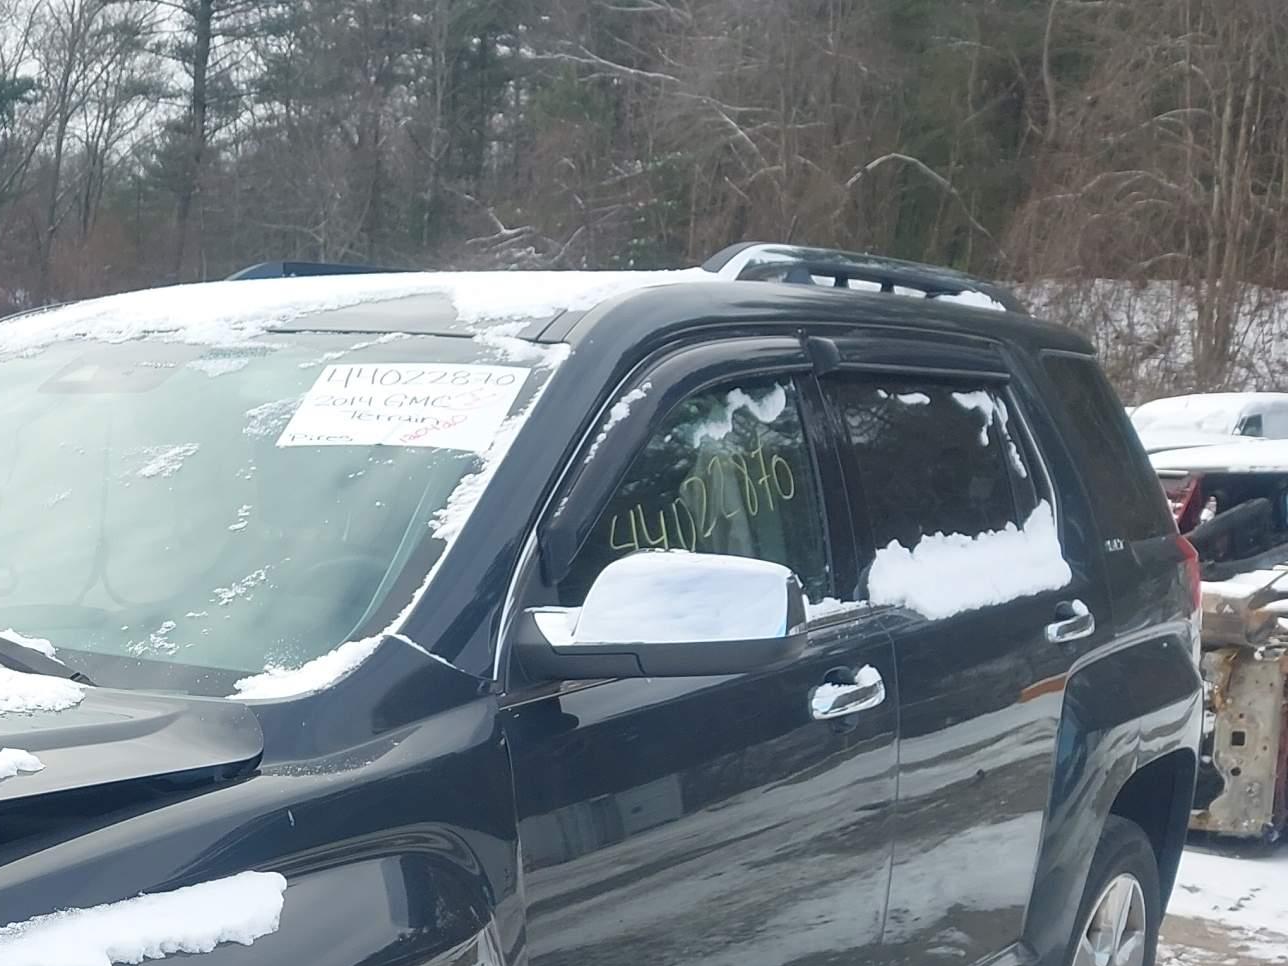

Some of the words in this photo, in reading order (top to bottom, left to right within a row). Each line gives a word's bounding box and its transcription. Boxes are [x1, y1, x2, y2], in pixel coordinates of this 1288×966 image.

[327, 367, 516, 389] 44022870
[313, 394, 372, 408] 2014
[383, 392, 452, 408] GMC
[341, 409, 440, 426] Terrain
